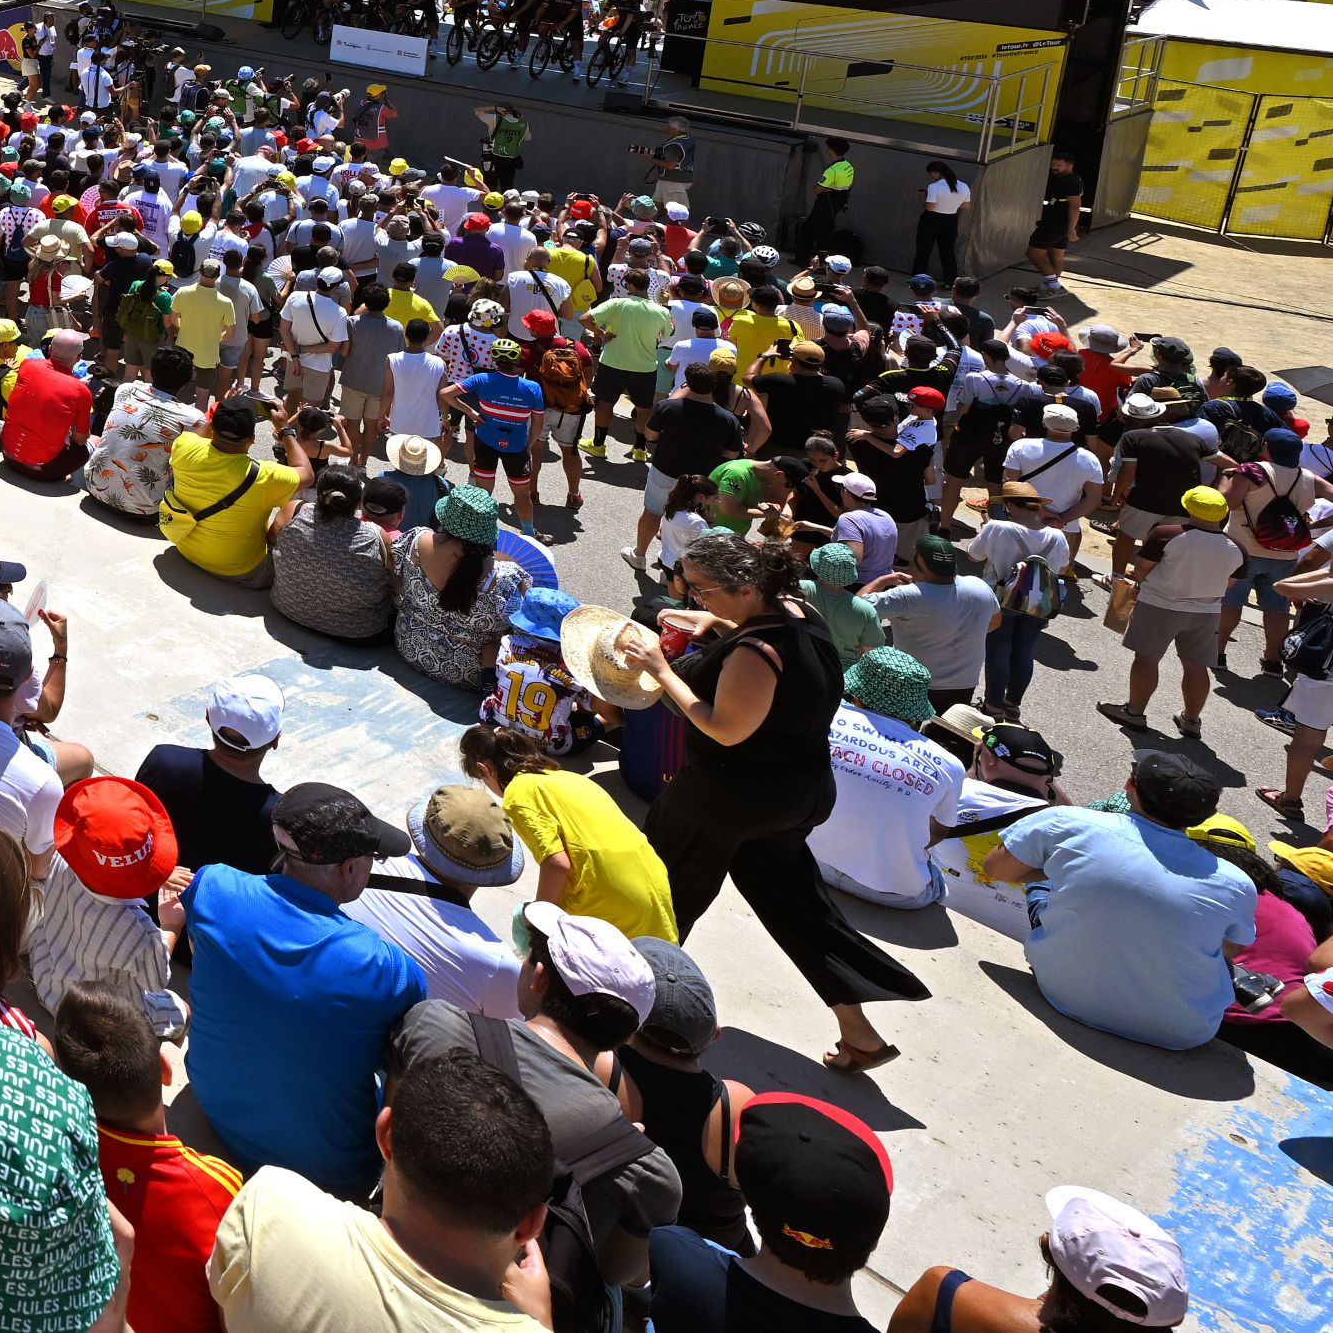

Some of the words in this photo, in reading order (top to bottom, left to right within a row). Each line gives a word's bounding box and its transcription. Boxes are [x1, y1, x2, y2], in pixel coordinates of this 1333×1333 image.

[1001, 43, 1029, 51] letour.fr
[1033, 39, 1061, 48] @LeTour
[506, 670, 557, 731] 19
[829, 729, 896, 759] AZARDOUS
[901, 756, 939, 780] AREA
[853, 723, 942, 766] SWIMMING
[871, 761, 935, 795] CLOSED
[92, 831, 153, 867] VELUX
[6, 1055, 64, 1089] JULES
[1, 1086, 62, 1125] JULES
[86, 1262, 117, 1286] JULES
[9, 1298, 60, 1316] JULES
[63, 1290, 103, 1312] JULES
[37, 1311, 82, 1333] JULES
